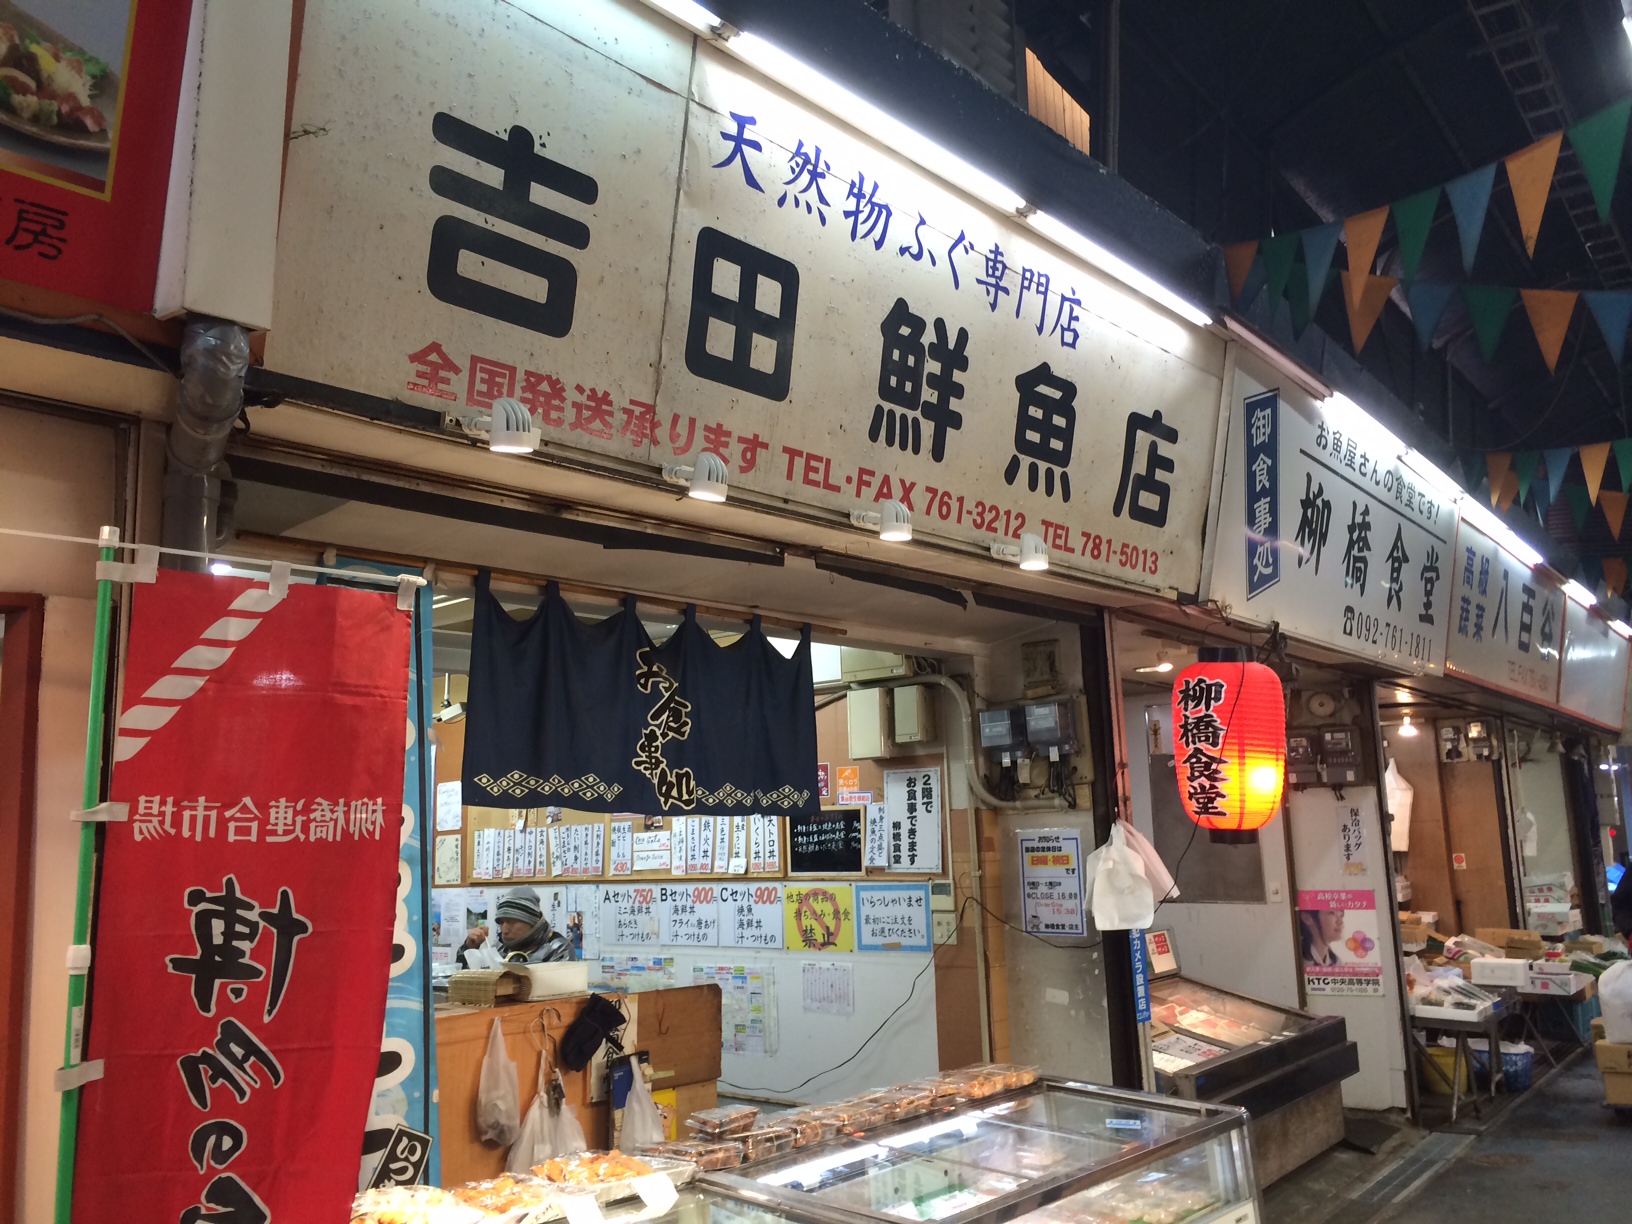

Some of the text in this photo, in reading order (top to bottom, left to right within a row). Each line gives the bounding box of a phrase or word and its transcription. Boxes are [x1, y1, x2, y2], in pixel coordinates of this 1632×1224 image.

[711, 111, 1082, 350] 天然物ふぐ専門店
[426, 111, 1180, 529] 吉田鮮魚店
[406, 341, 769, 474] 全国発送承ります
[925, 486, 1026, 540] 761-3212
[1041, 519, 1075, 554] TEL
[1080, 531, 1158, 575] 781-5013
[1250, 407, 1274, 583] 御食事処
[1294, 472, 1441, 627] 柳橋食堂
[1355, 609, 1433, 662] 092-761-1811
[1177, 677, 1231, 817] 柳橋食堂
[906, 776, 918, 866] お食事できます
[921, 773, 934, 814] 2階で
[892, 820, 902, 865] 柳橋食堂
[1341, 824, 1352, 862] あります
[802, 925, 838, 949] 禁止
[861, 895, 924, 908] いらっしゃいませ
